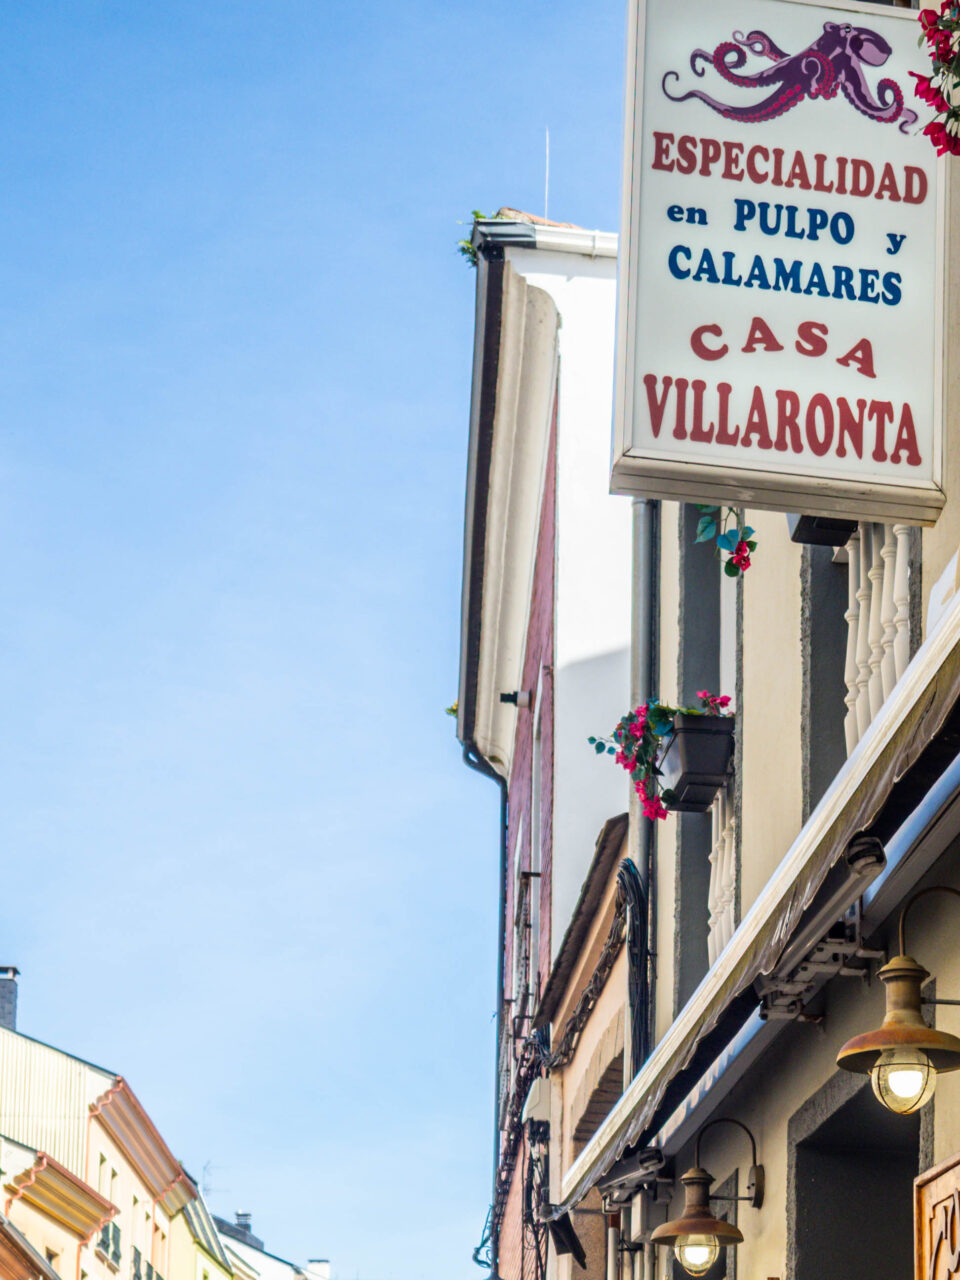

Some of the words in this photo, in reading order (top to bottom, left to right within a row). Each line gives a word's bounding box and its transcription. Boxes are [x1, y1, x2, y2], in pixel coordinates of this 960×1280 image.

[651, 131, 928, 204] ESPECIALIDAD
[666, 203, 708, 226] en
[733, 198, 855, 246] PULPO
[886, 230, 906, 255] y
[668, 244, 903, 305] CALAMARES
[690, 316, 877, 379] CASA
[643, 372, 922, 466] VILLARONTA
